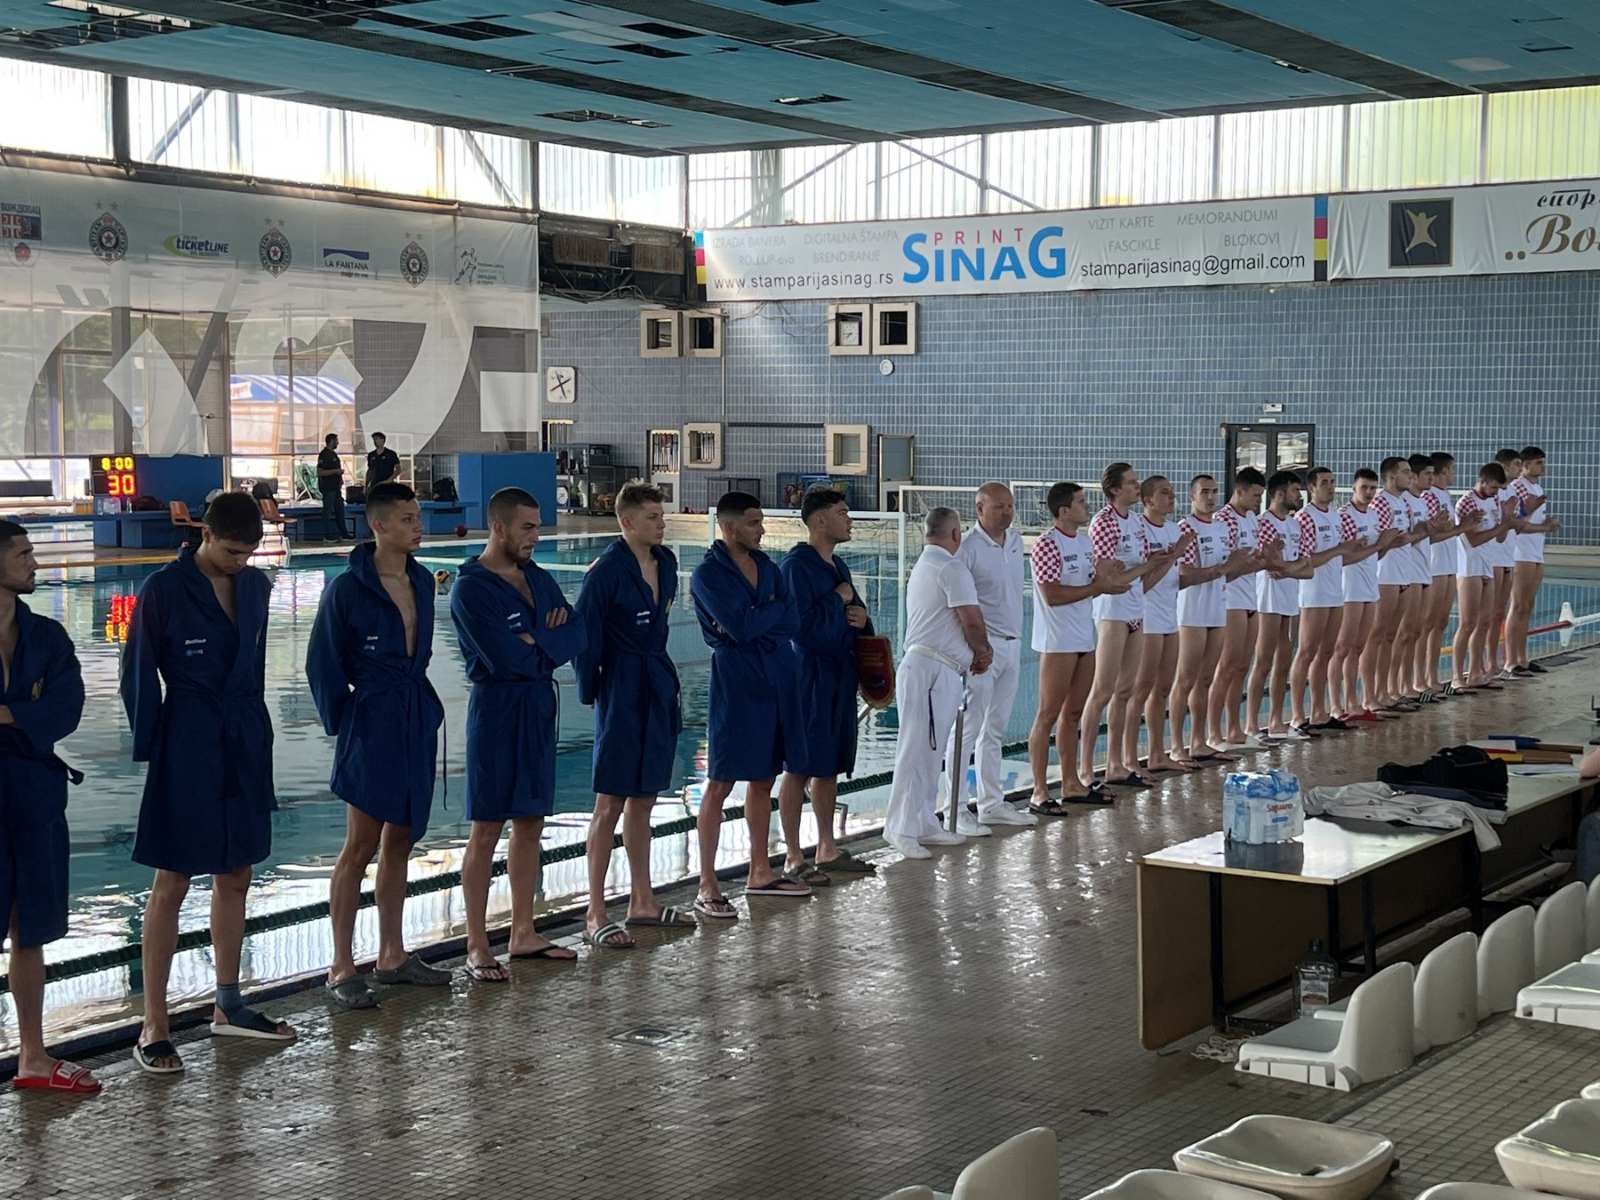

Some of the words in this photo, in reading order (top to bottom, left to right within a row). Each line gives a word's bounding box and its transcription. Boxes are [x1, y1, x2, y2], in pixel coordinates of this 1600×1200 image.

[1088, 217, 1115, 230] VIZIT
[1119, 215, 1155, 229] KARTE
[1177, 209, 1278, 226] MEMORANDUMI
[803, 231, 857, 246] DIGITALNA
[934, 227, 1024, 246] PRINT
[1108, 238, 1161, 252] FASCIKLE
[1224, 231, 1280, 248] BLOKOVI
[325, 260, 334, 268] LA
[1081, 253, 1305, 279] stamparijasinag@gmail.com
[714, 271, 894, 291] www.stamparijasinag.rs
[101, 457, 134, 471] 8:00
[107, 474, 135, 496] 30
